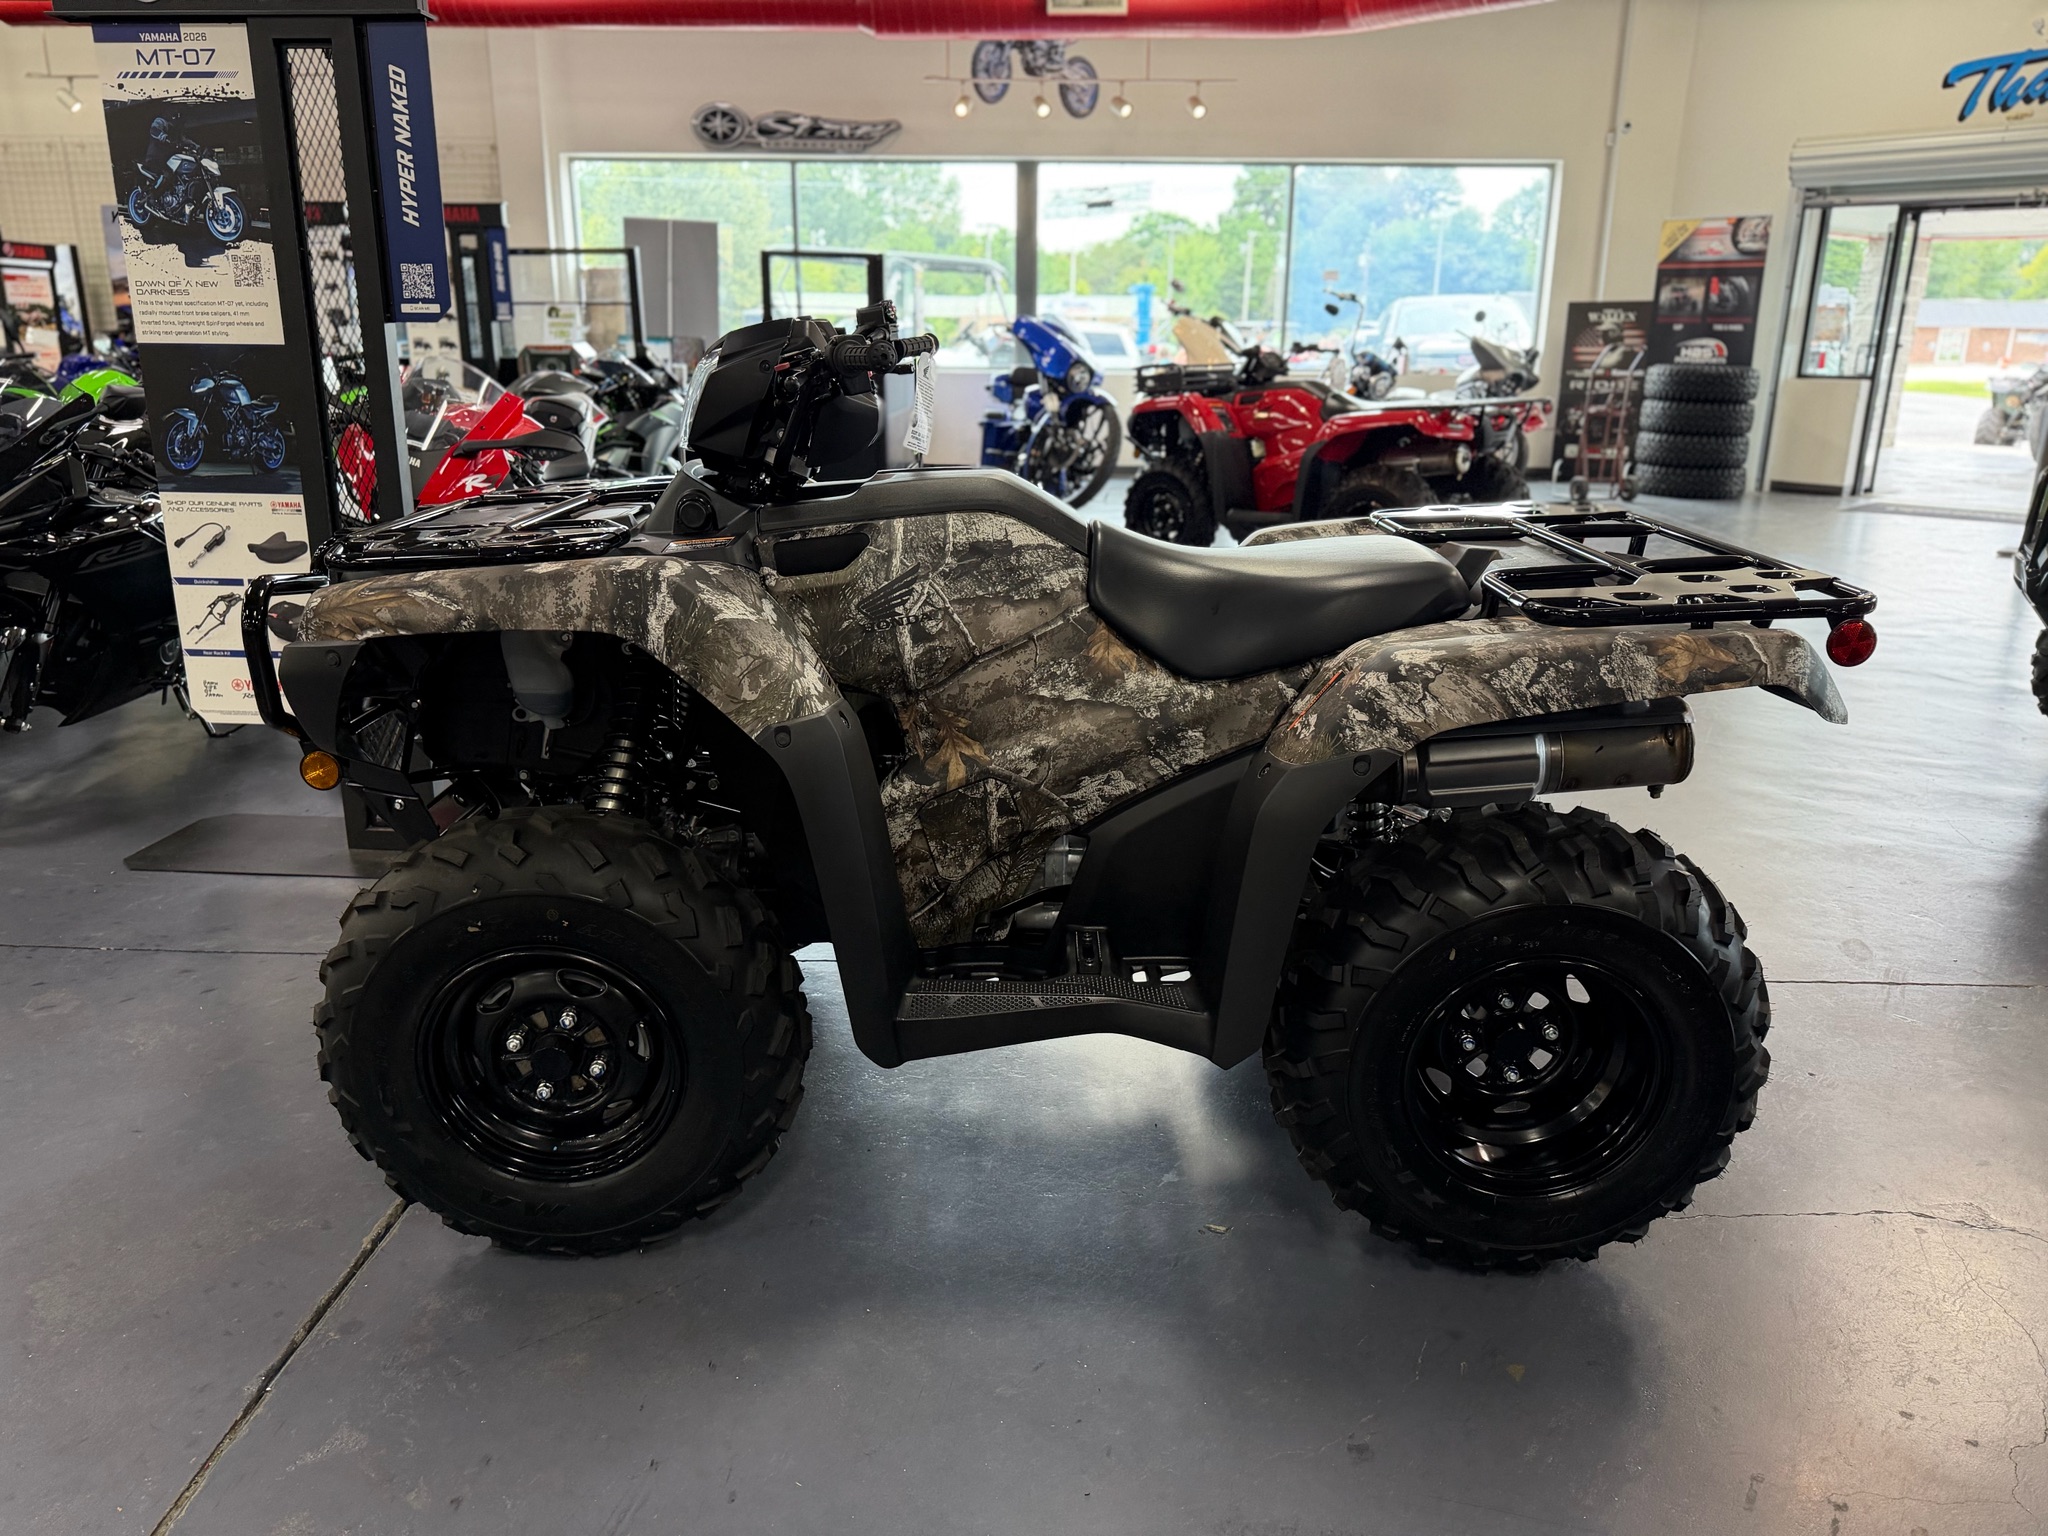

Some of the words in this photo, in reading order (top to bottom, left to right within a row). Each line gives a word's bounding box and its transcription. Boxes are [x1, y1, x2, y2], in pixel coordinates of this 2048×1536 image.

[138, 32, 180, 42] YAMAHA
[183, 32, 207, 41] 2026
[135, 48, 216, 66] MT-07
[388, 64, 412, 148] NAKED
[396, 148, 420, 228] HYPER
[135, 280, 165, 288] DAWN
[169, 280, 182, 288] OF
[185, 280, 193, 288] A
[136, 288, 190, 296] DARKNESS
[184, 300, 217, 308] specification
[277, 501, 302, 509] YAMAHA
